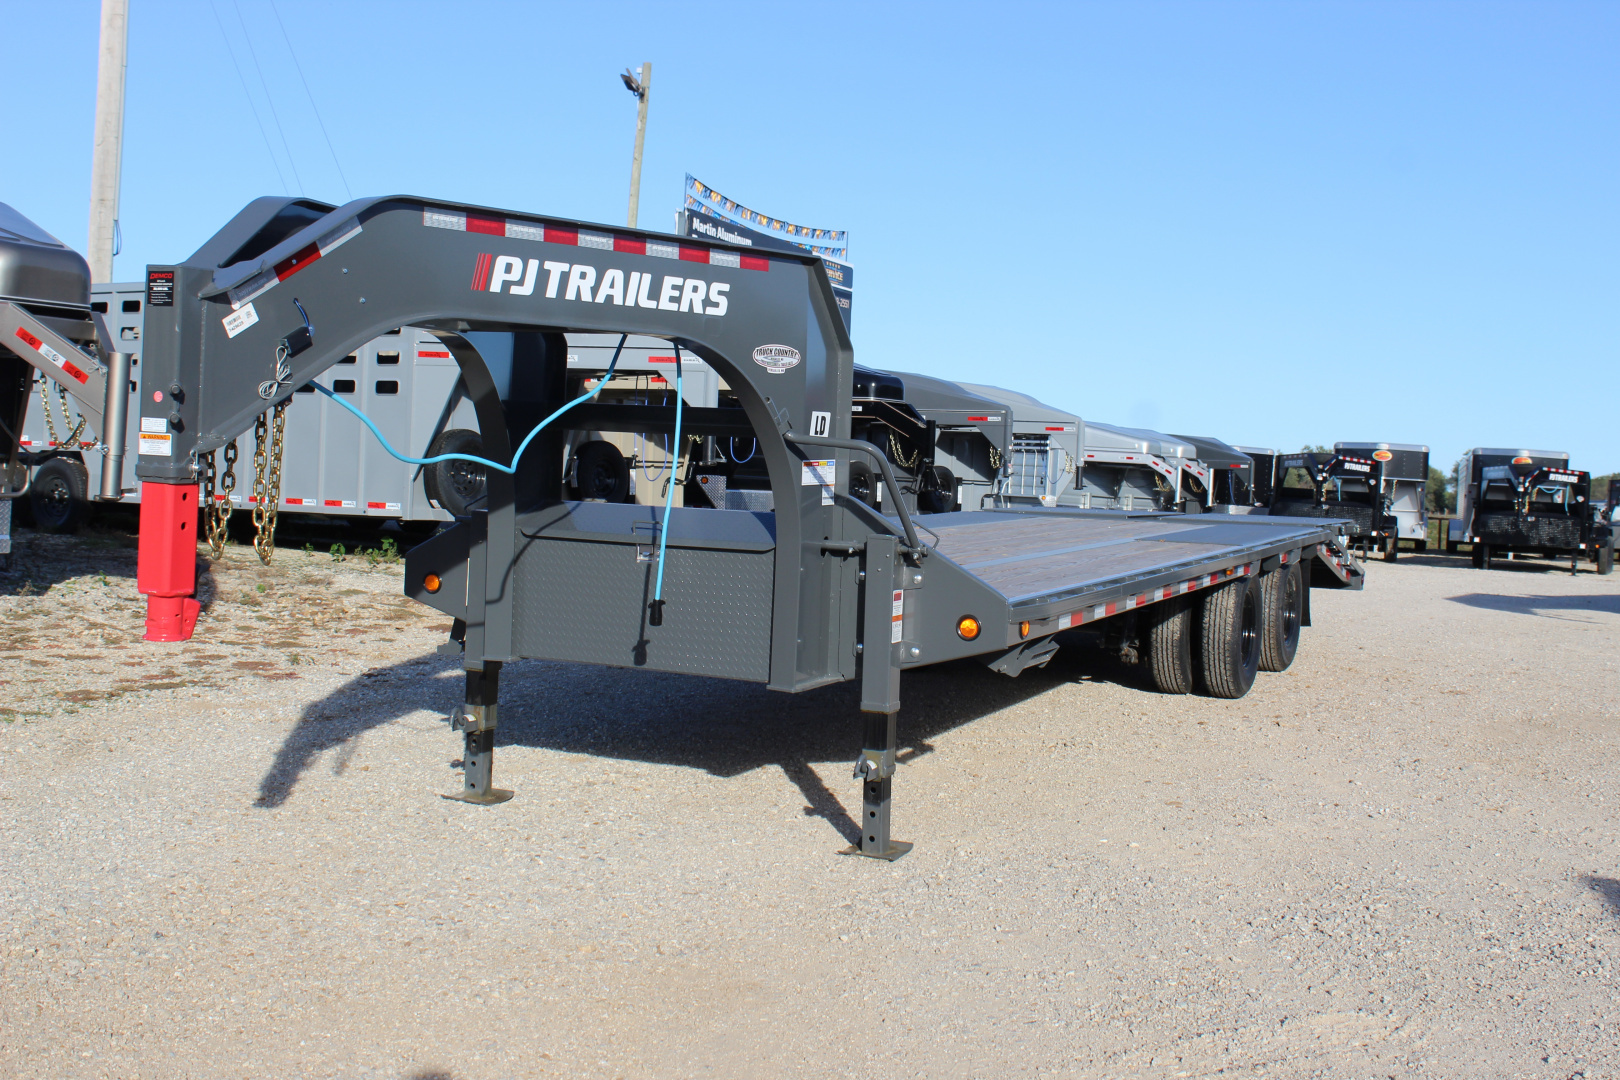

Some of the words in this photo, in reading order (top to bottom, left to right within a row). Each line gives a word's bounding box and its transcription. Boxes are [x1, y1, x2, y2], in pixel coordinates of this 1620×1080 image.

[692, 217, 717, 238] Martin
[717, 227, 752, 246] Aluminum
[756, 348, 774, 357] TRUCK
[814, 415, 827, 436] LD
